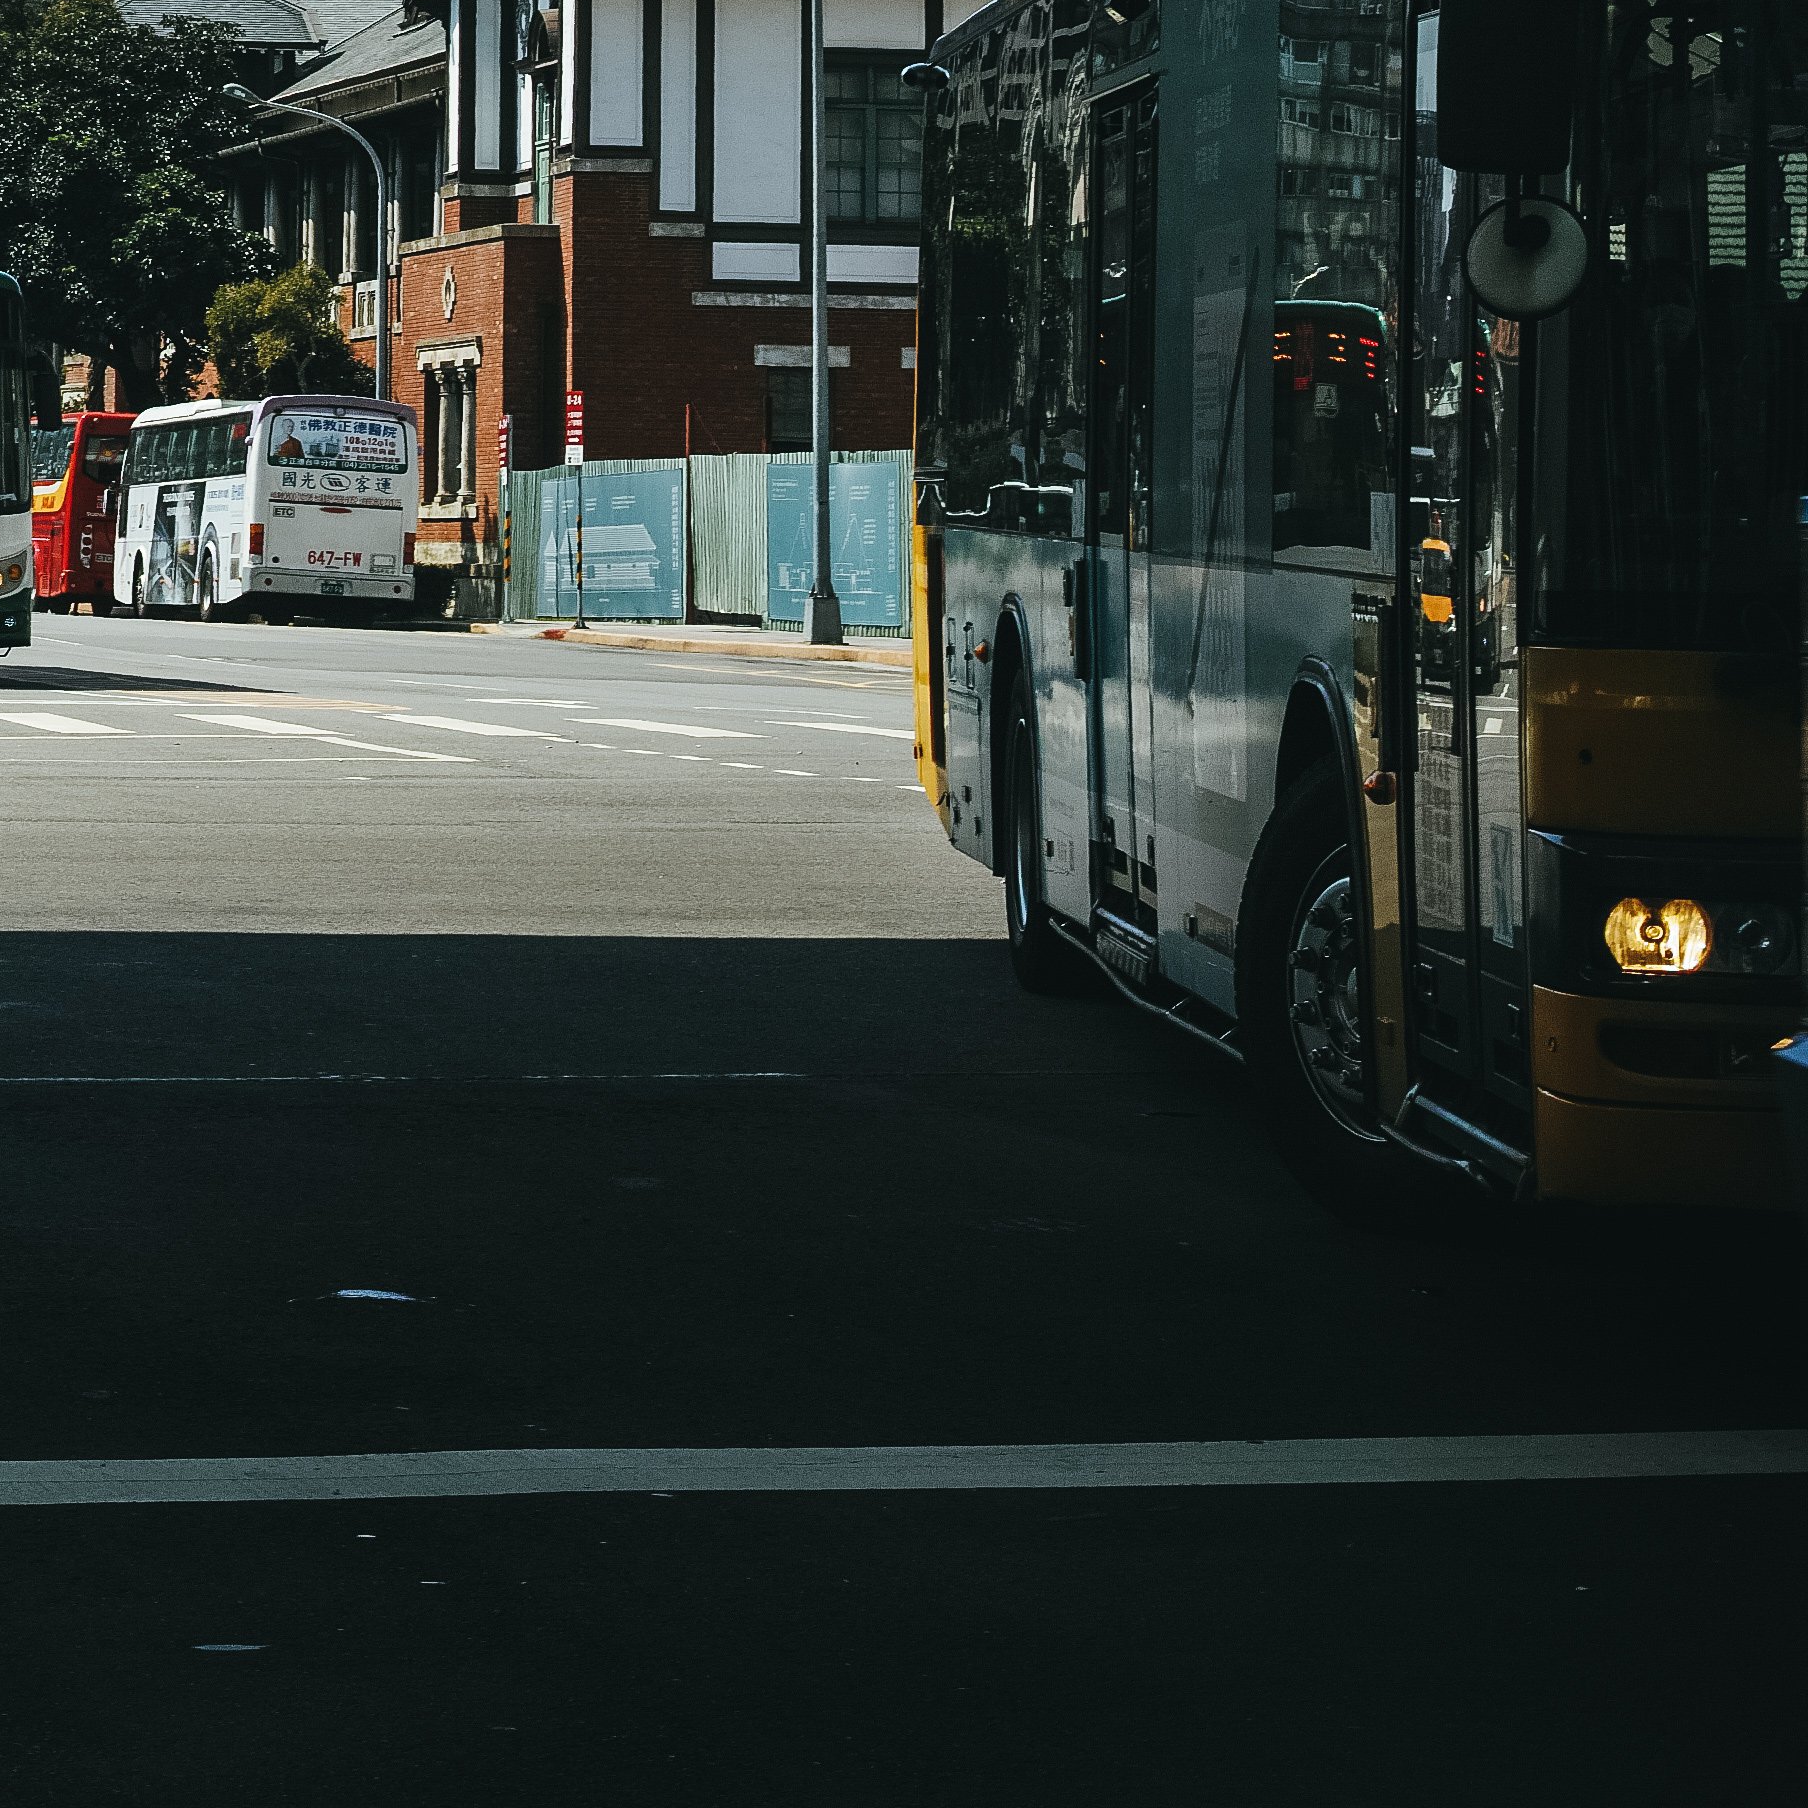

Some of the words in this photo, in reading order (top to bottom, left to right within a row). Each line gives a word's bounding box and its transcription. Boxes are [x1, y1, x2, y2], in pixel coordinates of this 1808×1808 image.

[308, 419, 398, 438] 佛教正德醫院
[282, 471, 316, 490] 國光
[355, 475, 394, 494] 客運
[274, 508, 294, 517] ETC
[95, 554, 112, 562] ETC
[307, 550, 363, 567] 647-FW
